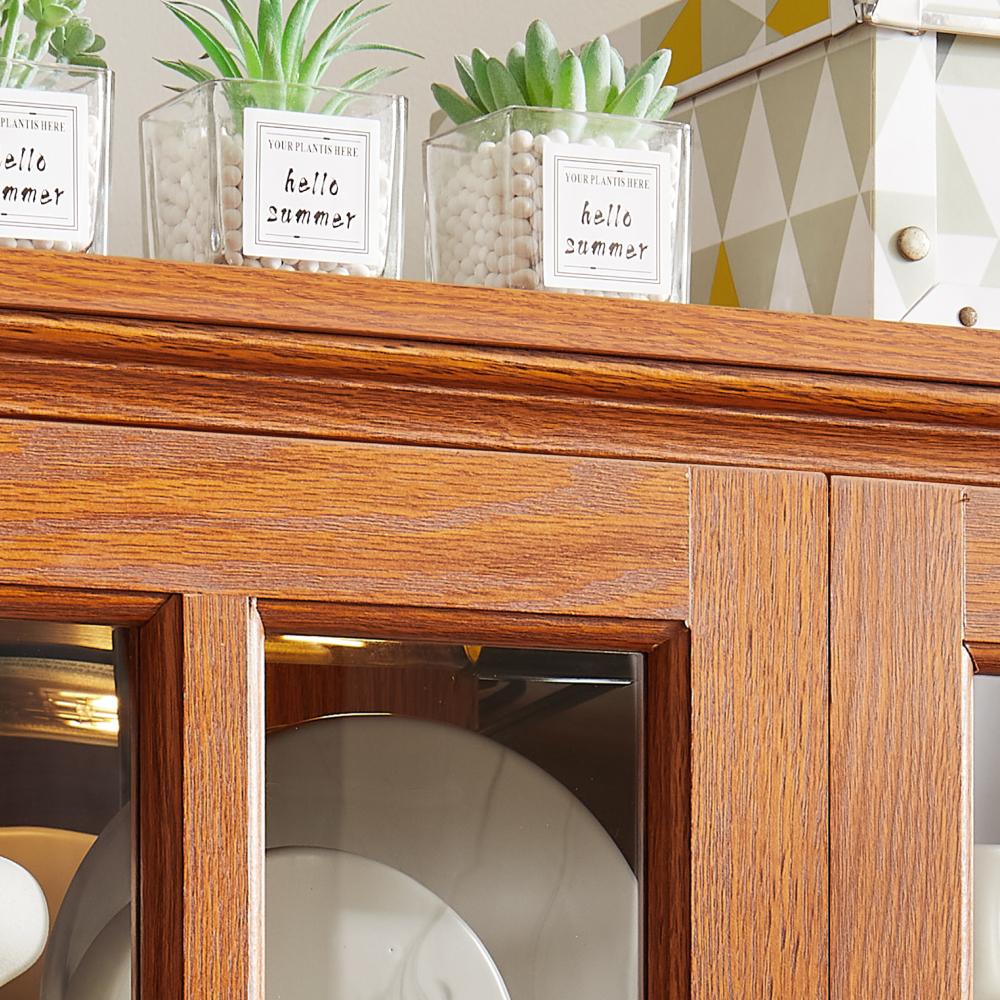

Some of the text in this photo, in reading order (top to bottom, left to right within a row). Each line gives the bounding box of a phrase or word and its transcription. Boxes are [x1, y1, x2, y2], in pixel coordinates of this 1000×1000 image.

[41, 120, 66, 132] HERE
[268, 139, 293, 152] YOUR
[334, 145, 358, 157] HERE
[285, 168, 339, 195] hello
[565, 172, 588, 184] YOUR
[627, 178, 650, 189] HERE
[267, 205, 357, 229] summer
[581, 200, 632, 227] hello
[564, 238, 649, 260] summer
